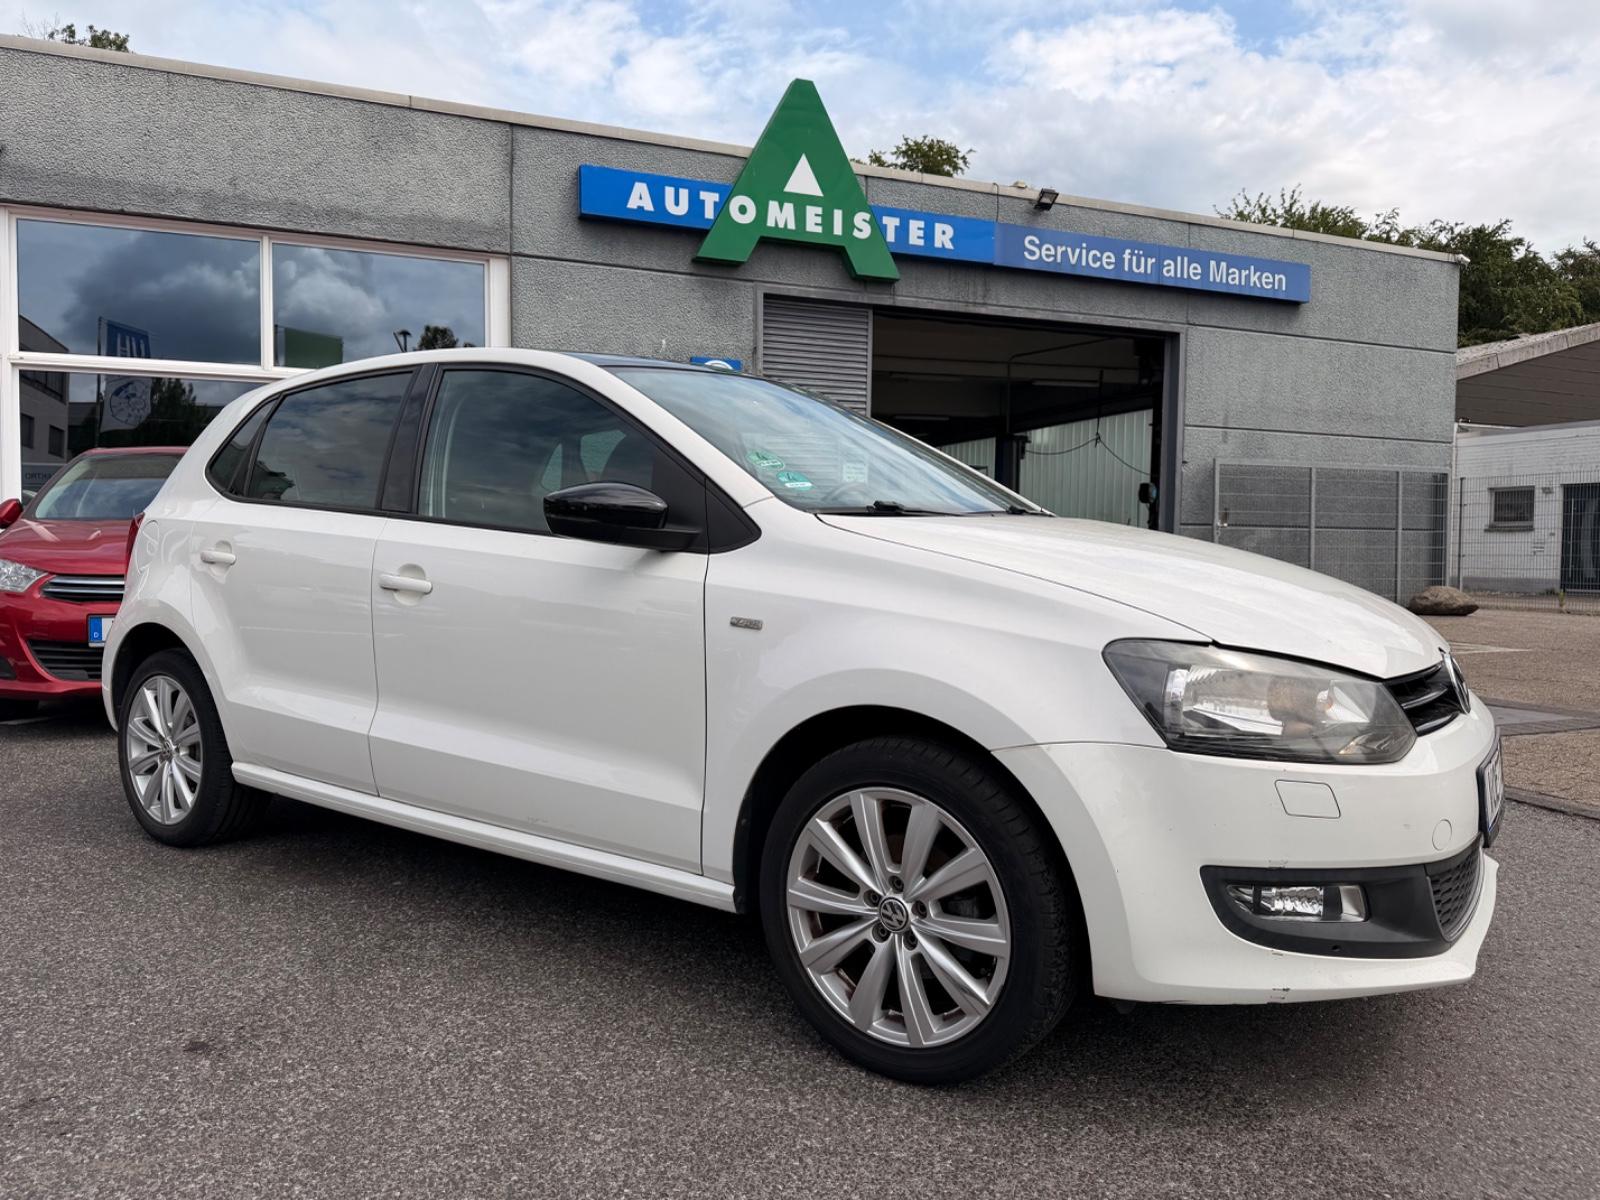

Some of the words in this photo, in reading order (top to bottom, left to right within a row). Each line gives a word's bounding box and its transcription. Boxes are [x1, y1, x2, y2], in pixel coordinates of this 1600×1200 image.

[626, 181, 954, 250] AUTOMEISTER
[1023, 234, 1116, 270] Service
[1122, 248, 1156, 275] für
[1162, 255, 1202, 280] alle
[1208, 259, 1287, 291] Marken
